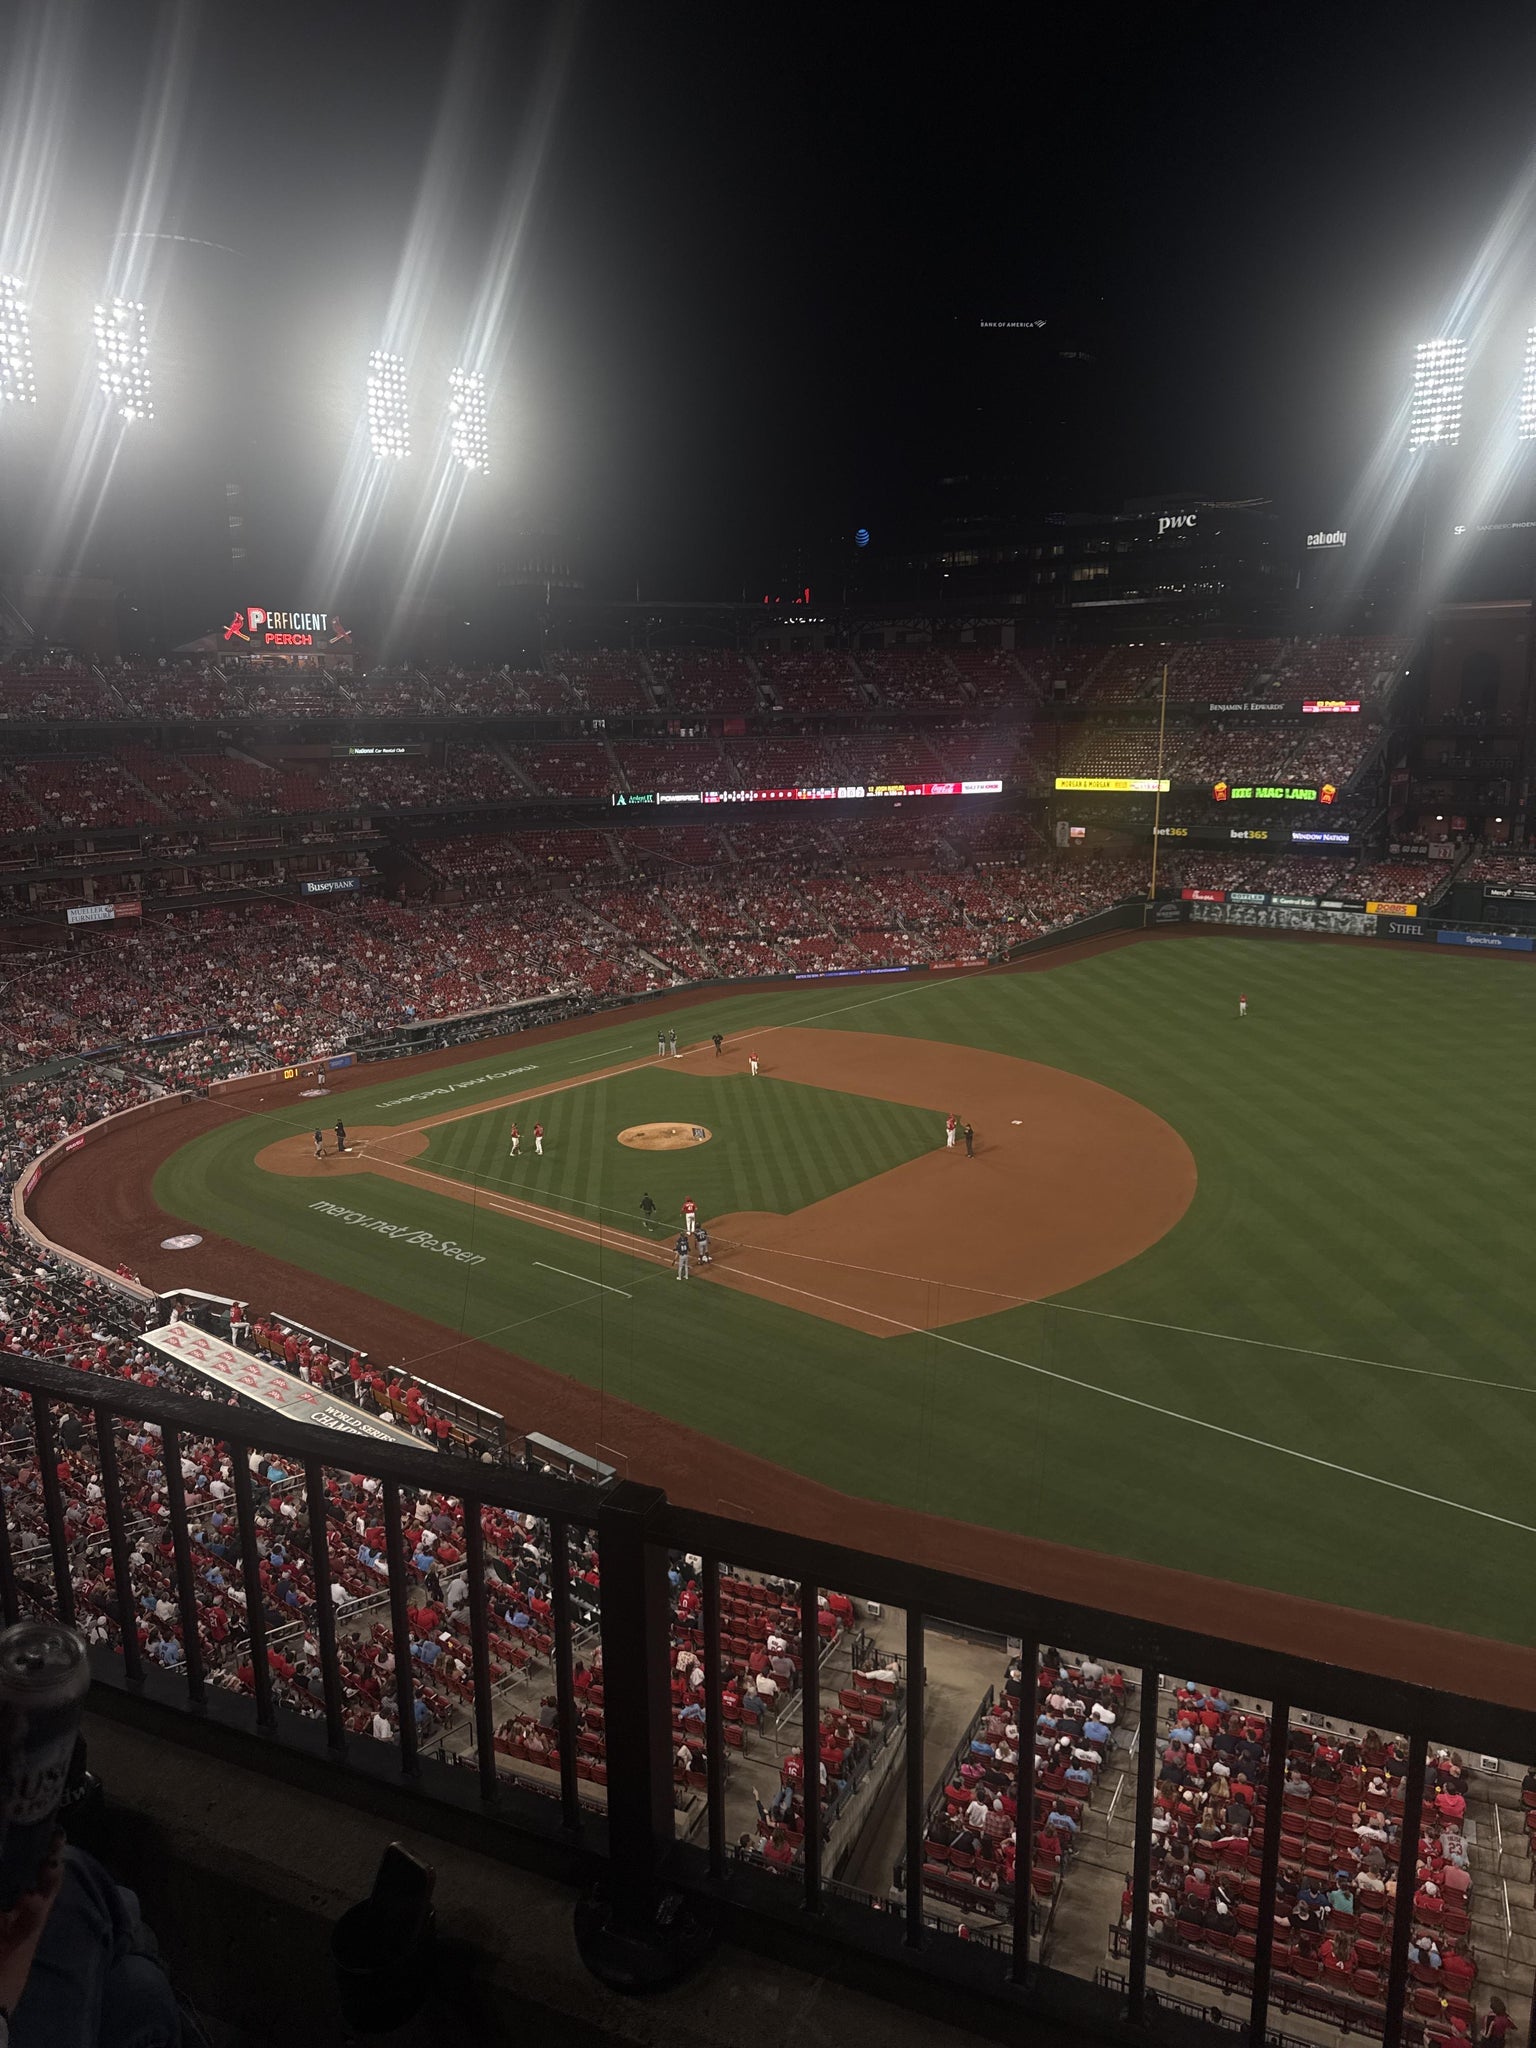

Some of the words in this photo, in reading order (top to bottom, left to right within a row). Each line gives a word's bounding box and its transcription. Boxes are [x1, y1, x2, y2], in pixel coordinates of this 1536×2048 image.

[1158, 513, 1197, 534] pwc
[246, 607, 328, 632] PERFICIENT
[264, 632, 313, 645] PERCH
[1209, 703, 1243, 711] BENJAMIN
[1255, 787, 1283, 798] MAC
[1284, 788, 1317, 800] LAND
[1230, 829, 1268, 840] bet365
[1292, 832, 1322, 841] WINDOW
[1323, 833, 1350, 842] NATION
[307, 880, 354, 892] BuseyBANK
[1491, 889, 1507, 897] Mercy
[71, 907, 103, 915] MUELLER
[1377, 903, 1407, 913] DOBBS
[71, 913, 112, 922] FURNITURE
[1389, 922, 1423, 936] STIFEL
[1466, 936, 1499, 945] Spectrum
[308, 1200, 487, 1266] mercy.net/BeSeen
[310, 1411, 369, 1437] CHAMP
[325, 1406, 361, 1427] WORLD
[359, 1424, 397, 1442] SERIES
[1448, 1843, 1463, 1856] 23
